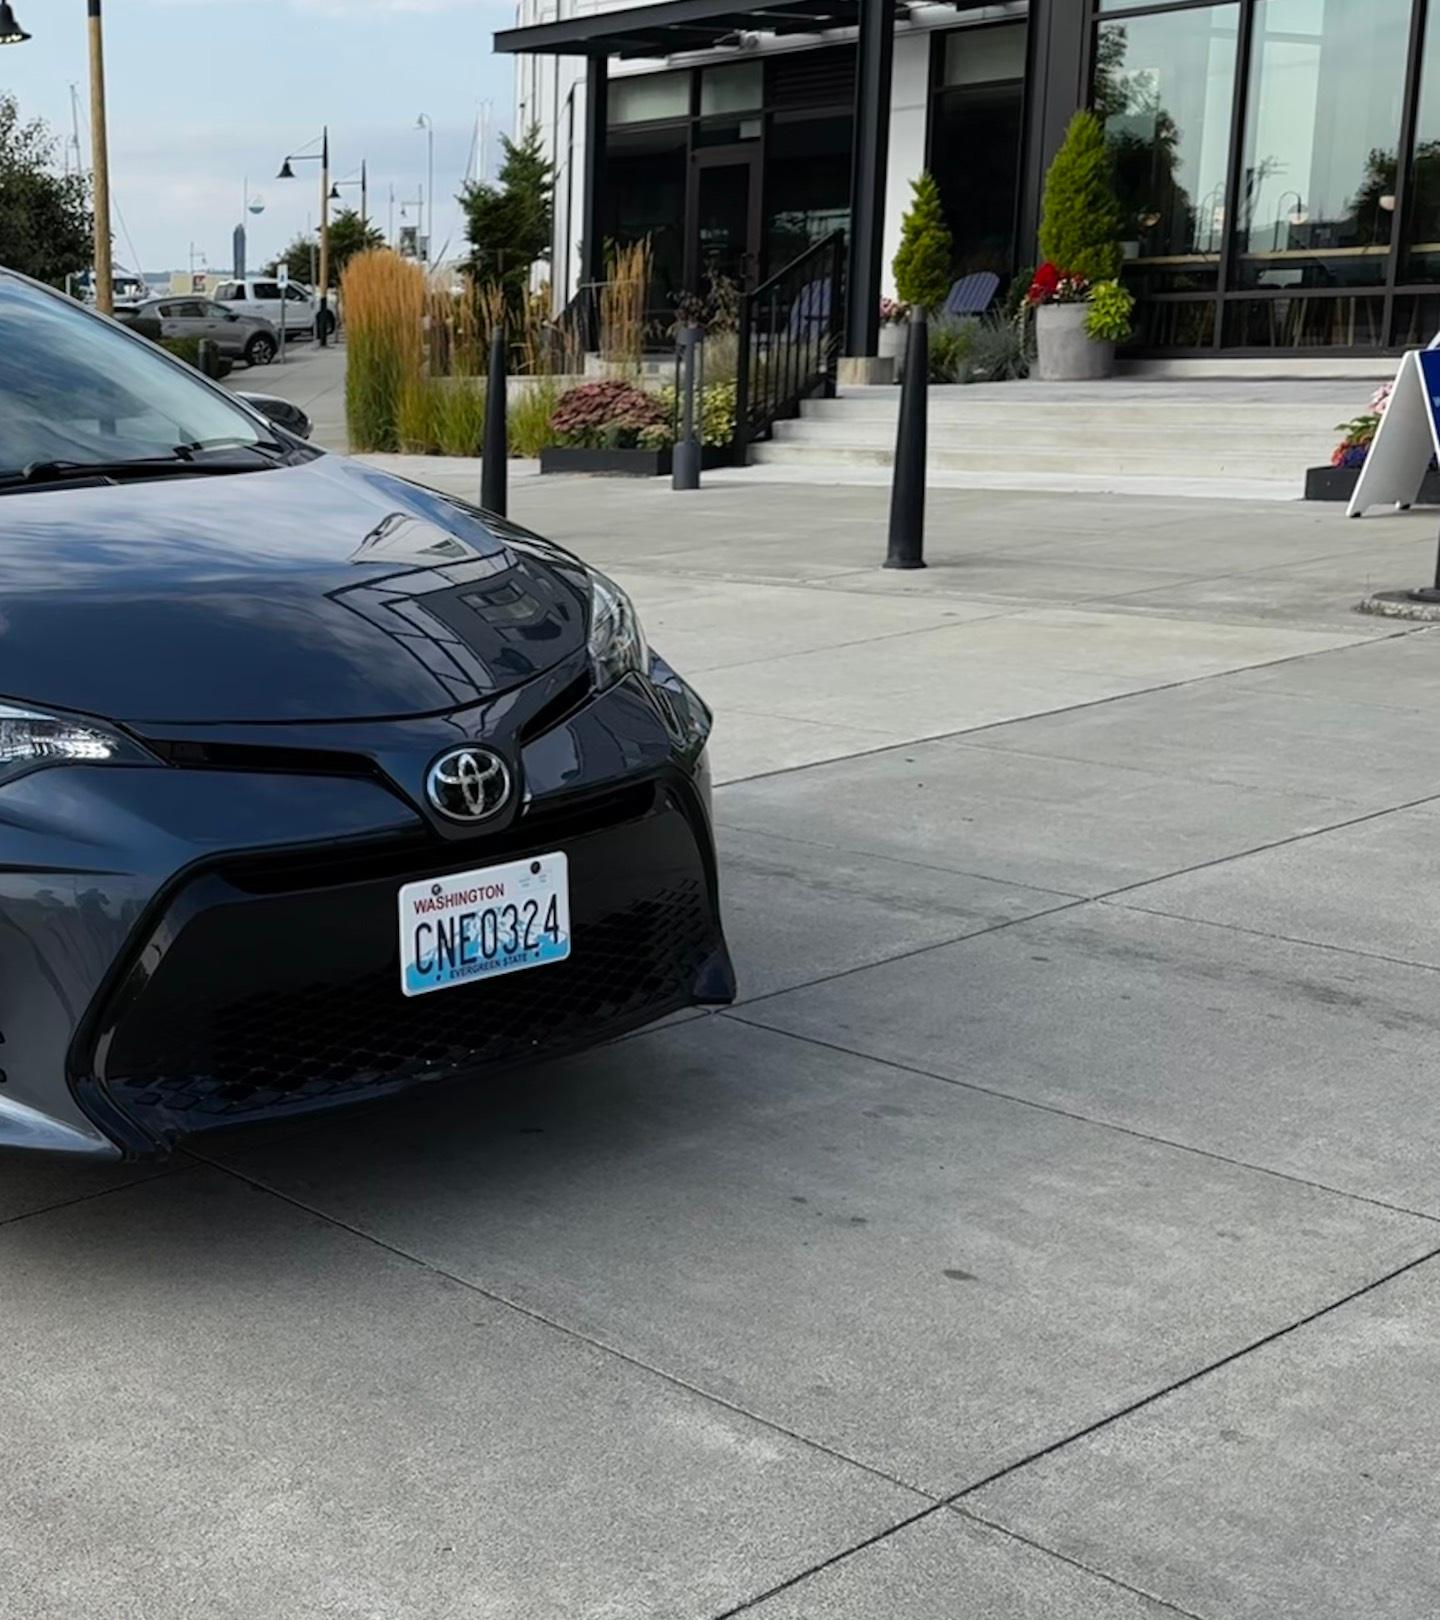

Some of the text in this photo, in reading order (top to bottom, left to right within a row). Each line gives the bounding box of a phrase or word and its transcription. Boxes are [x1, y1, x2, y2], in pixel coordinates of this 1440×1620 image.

[413, 883, 505, 915] WASHINGTON
[414, 892, 560, 975] CNE0324
[449, 953, 528, 979] EVERGREEN STATE
